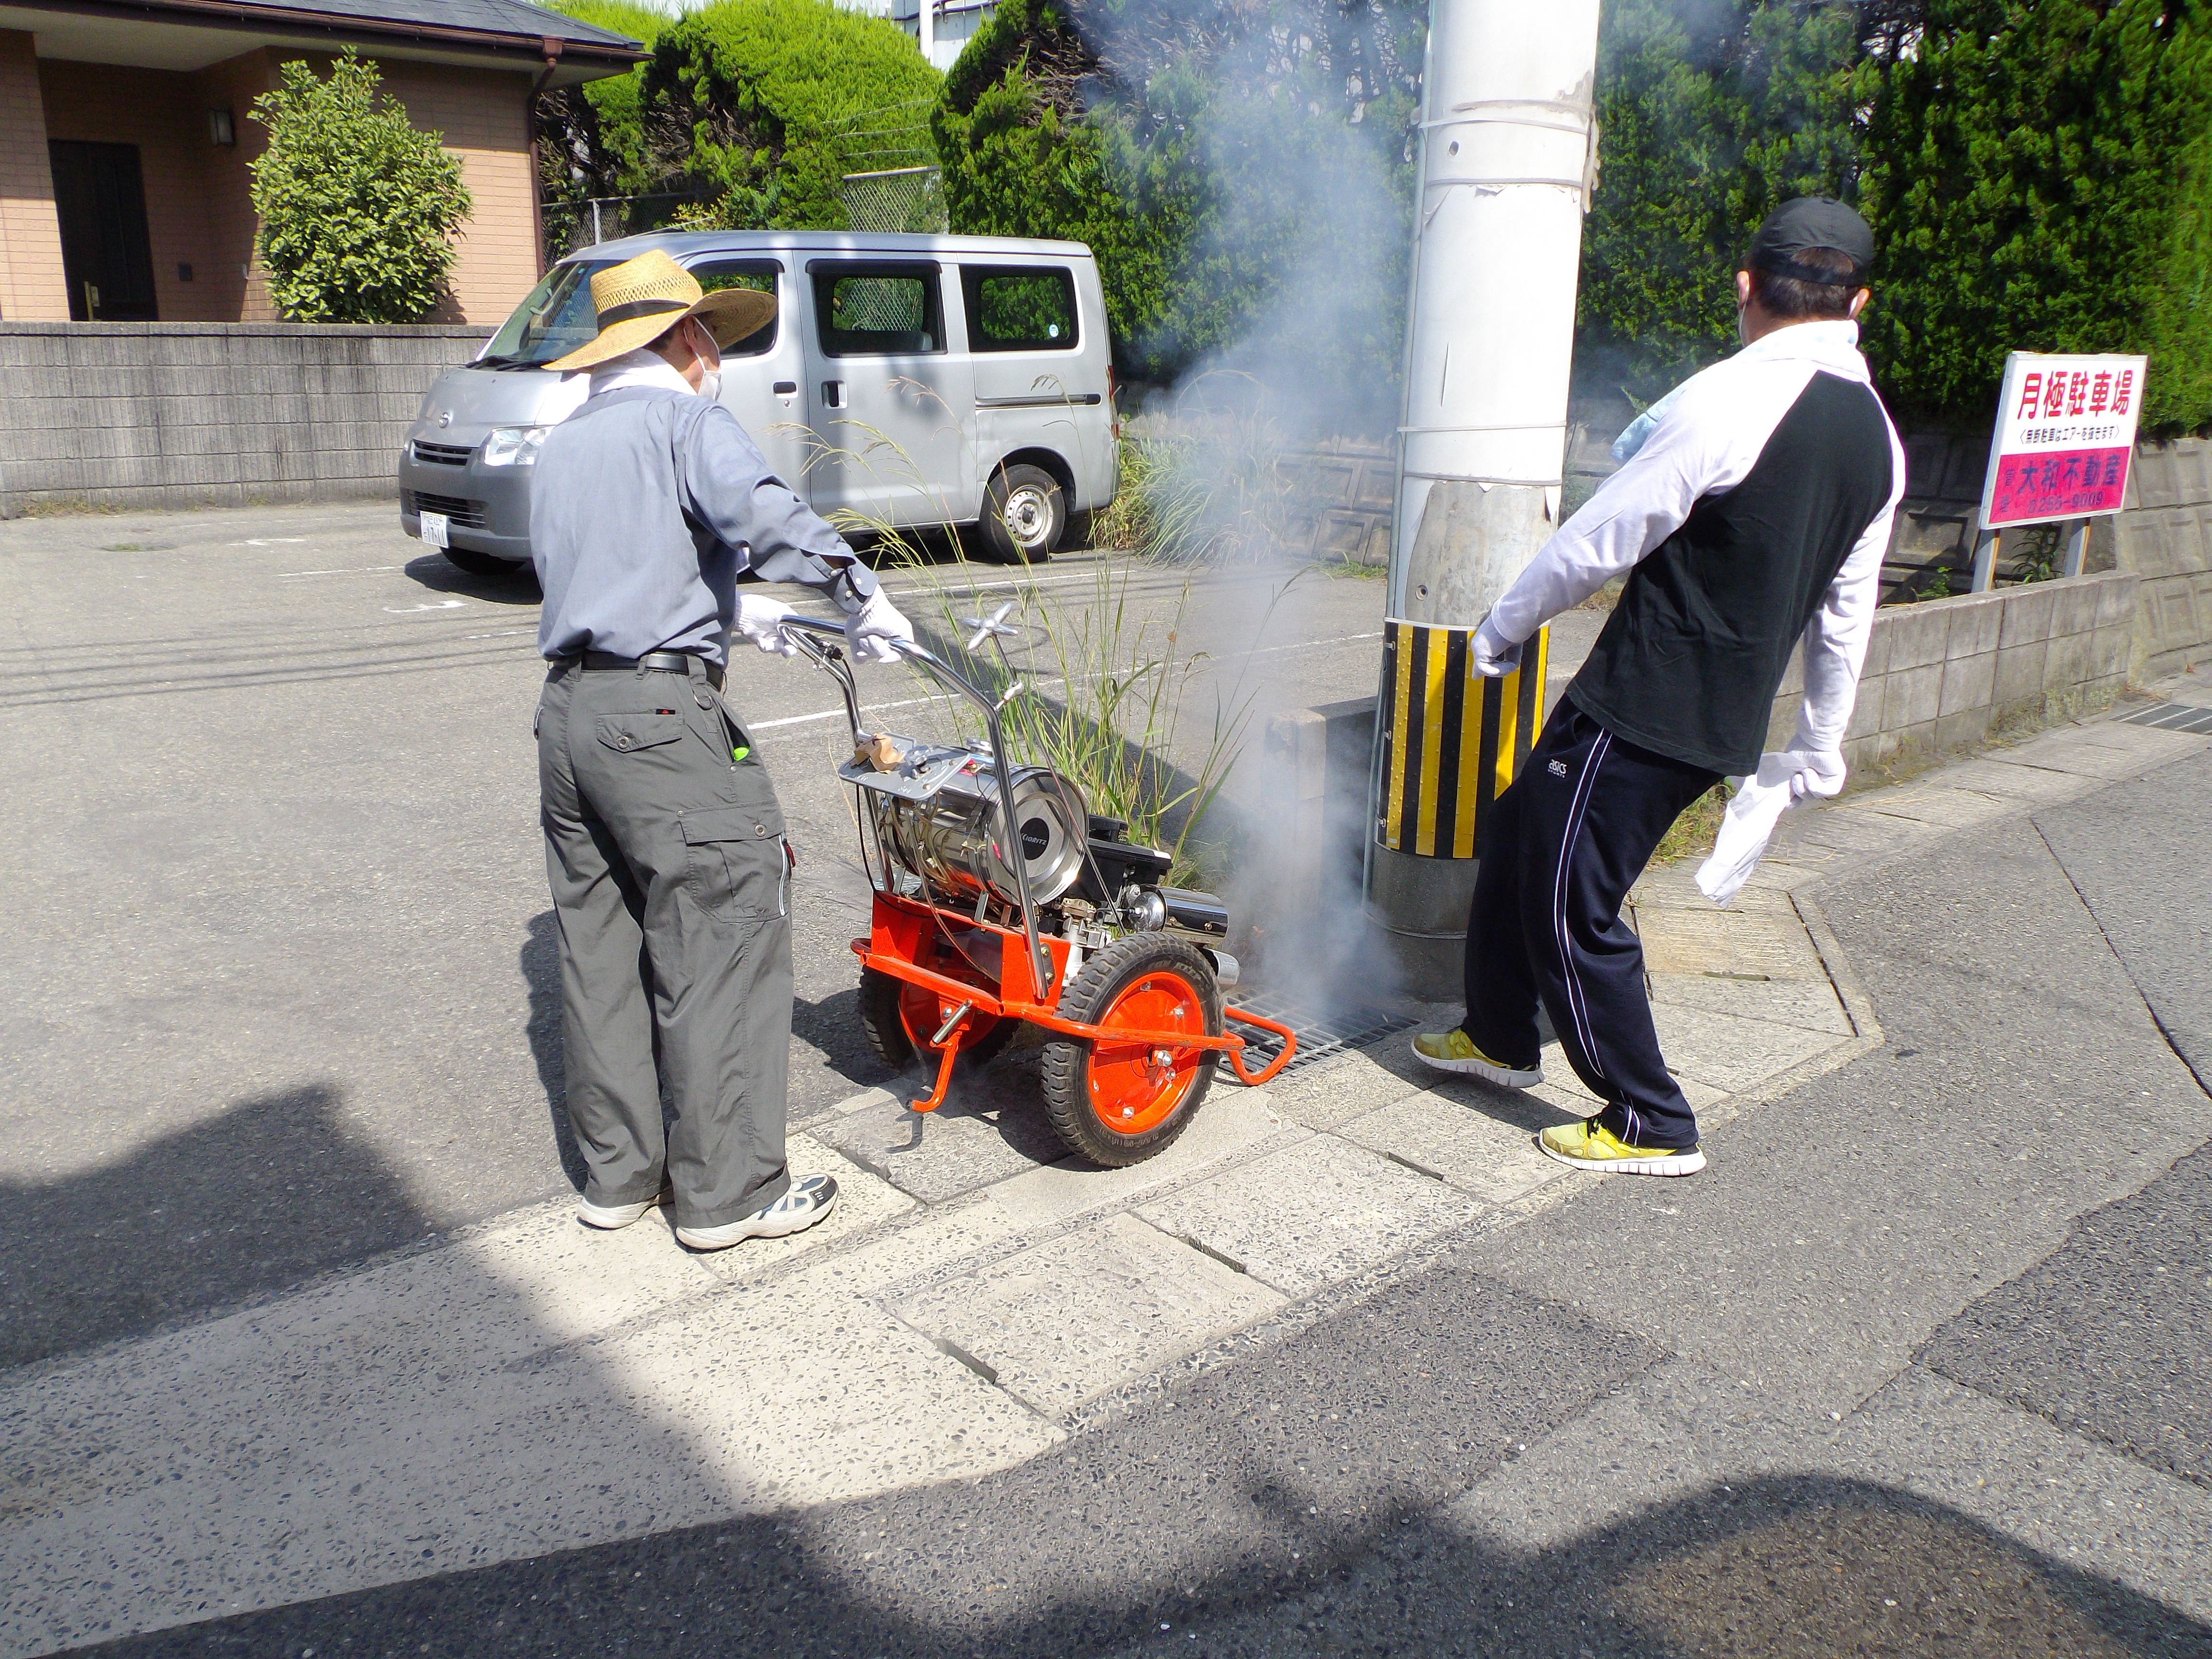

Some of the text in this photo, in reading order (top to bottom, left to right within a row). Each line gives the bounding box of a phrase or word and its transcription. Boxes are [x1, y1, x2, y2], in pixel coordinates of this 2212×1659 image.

[2017, 370, 2133, 420] 月極駐車場
[2017, 454, 2121, 495] 大和不動産
[1549, 759, 1567, 774] asics
